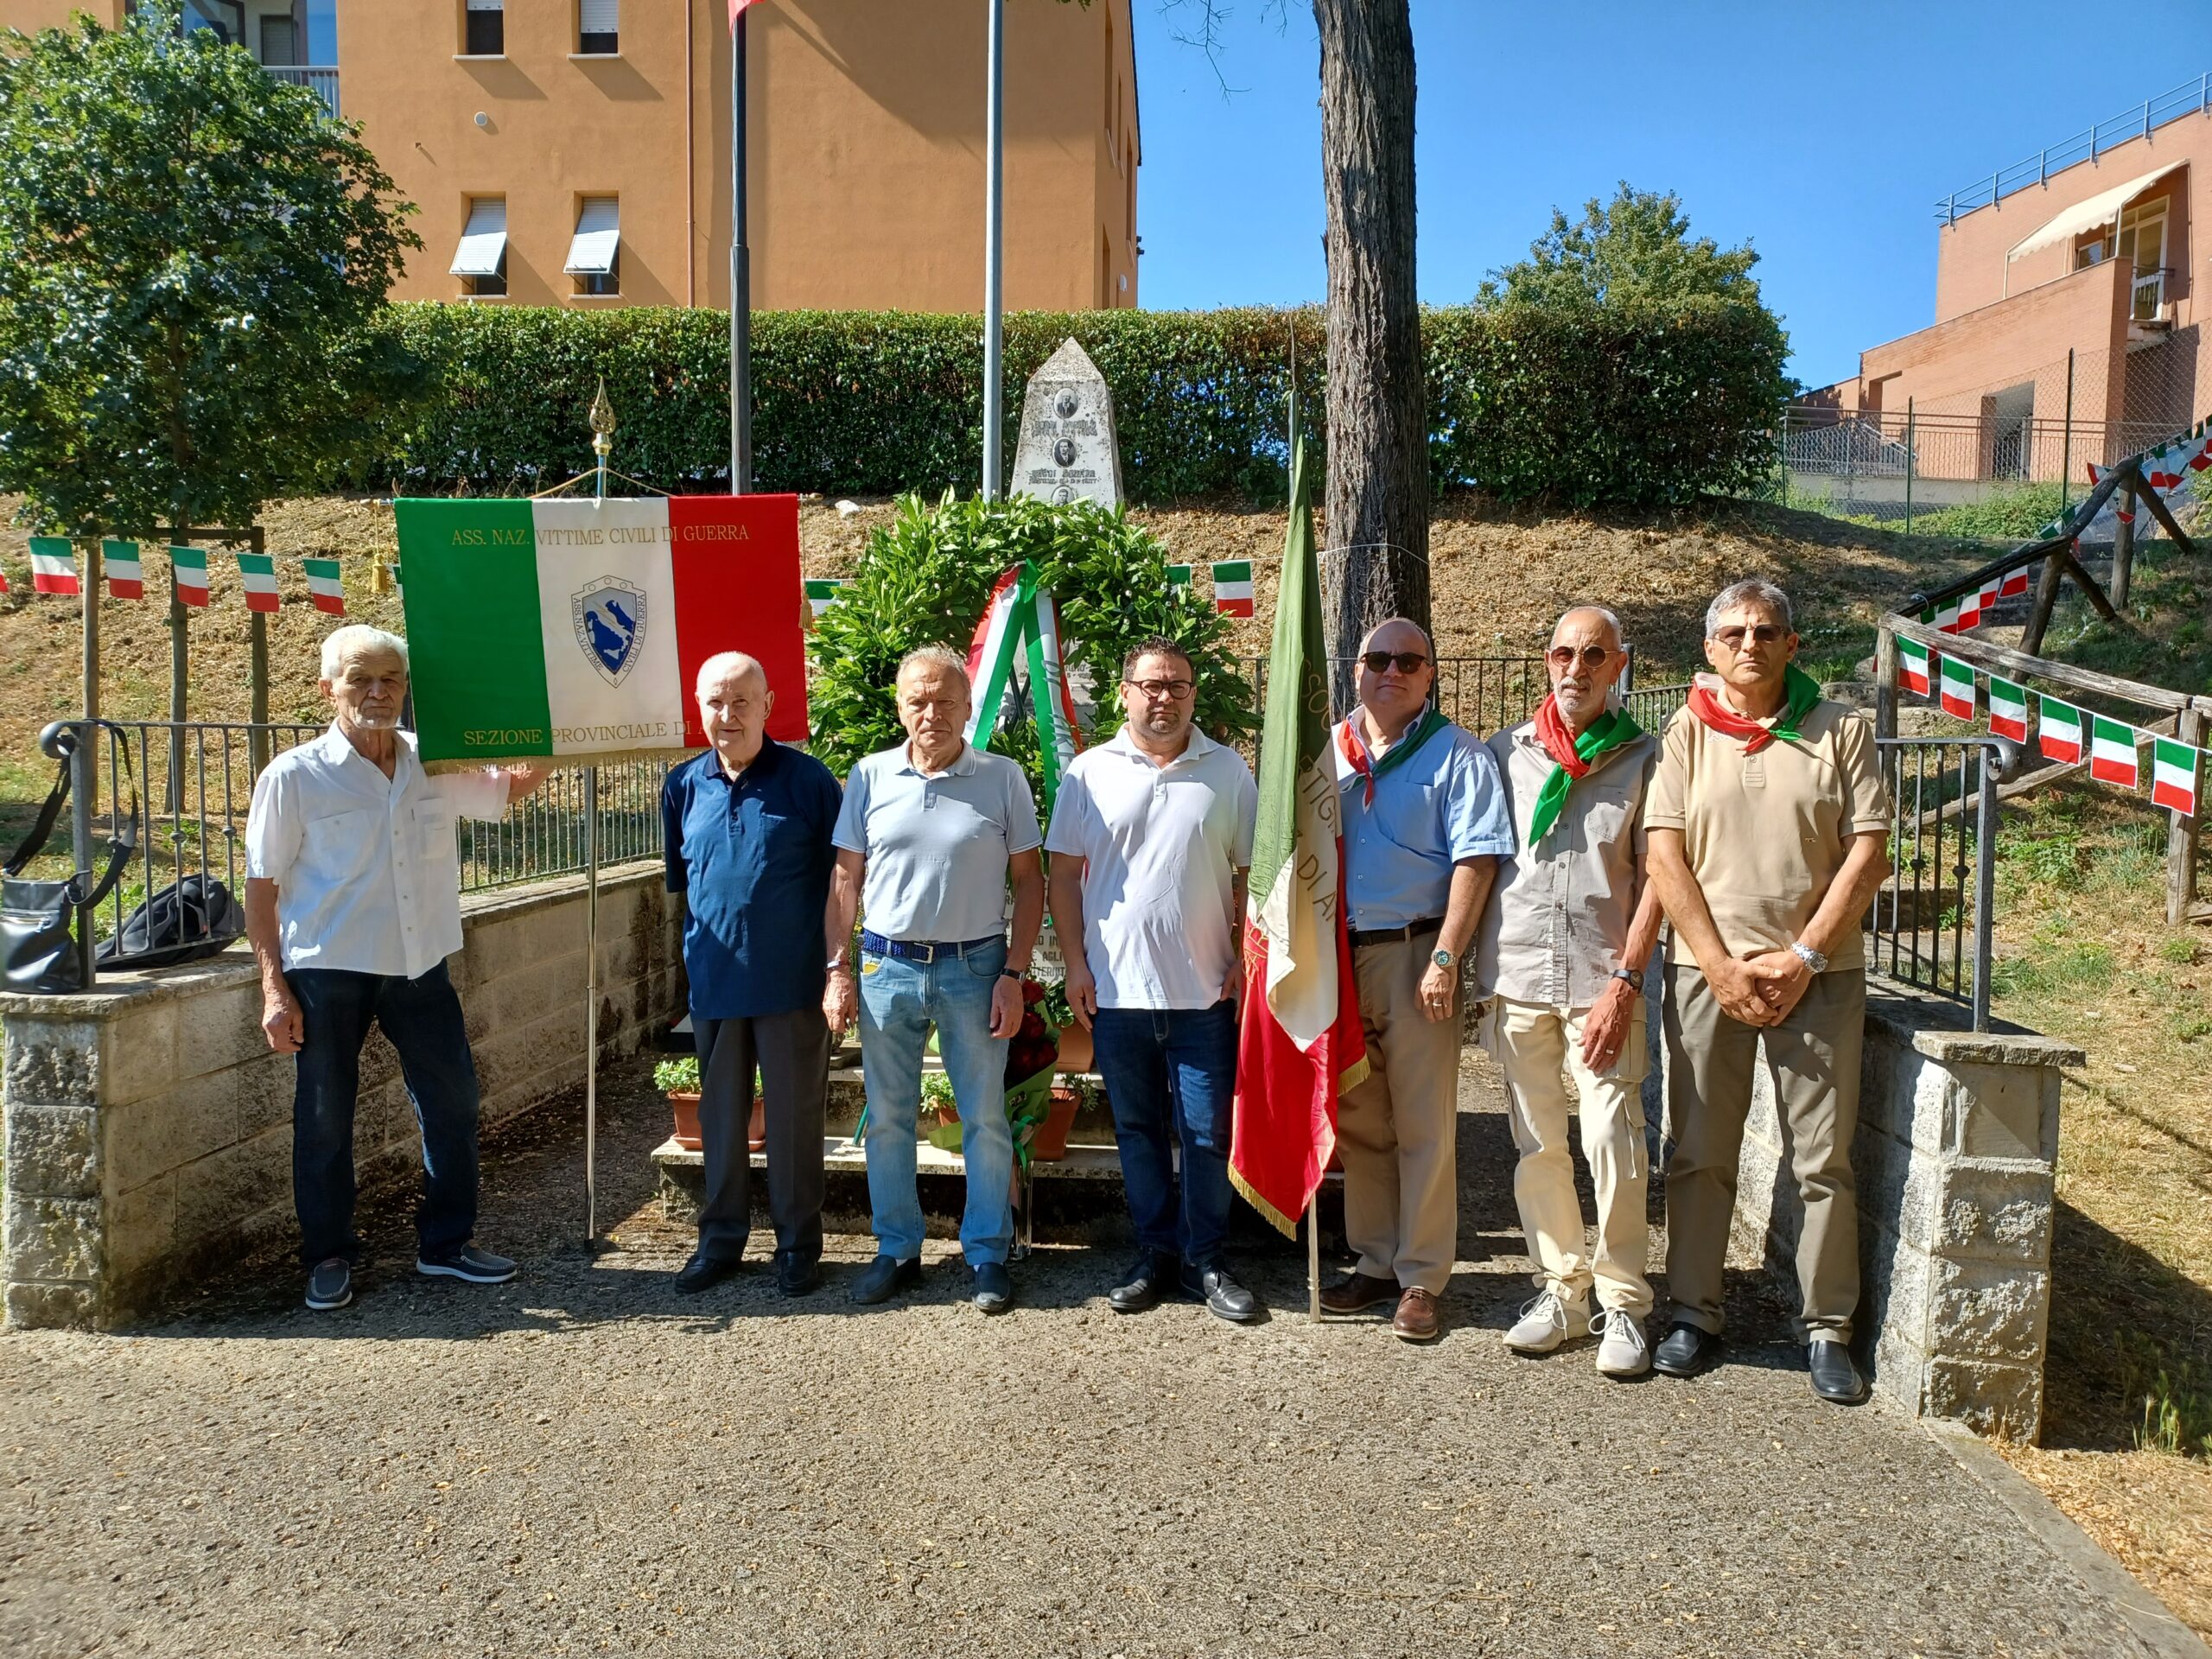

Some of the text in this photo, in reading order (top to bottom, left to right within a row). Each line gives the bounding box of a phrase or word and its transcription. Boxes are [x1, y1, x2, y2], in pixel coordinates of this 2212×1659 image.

[452, 524, 750, 545] ASS. NAZ. VITTIME CIVILI DI GUERRA
[464, 728, 543, 746] SEZIONE
[550, 721, 668, 744] PROVINCIALE
[673, 721, 692, 735] DI
